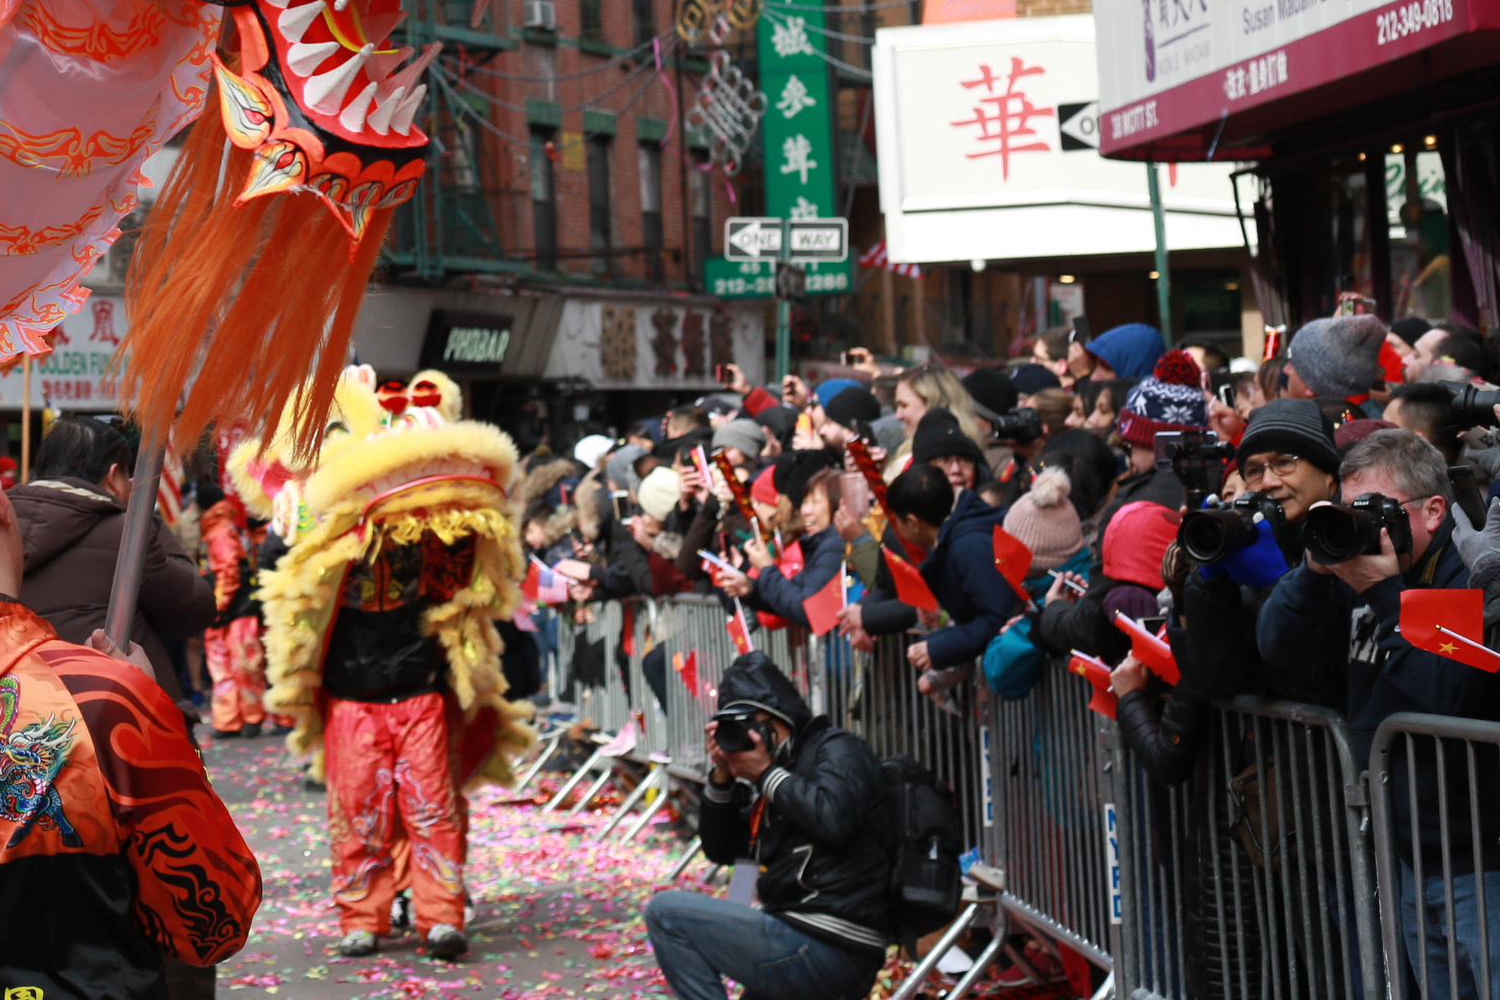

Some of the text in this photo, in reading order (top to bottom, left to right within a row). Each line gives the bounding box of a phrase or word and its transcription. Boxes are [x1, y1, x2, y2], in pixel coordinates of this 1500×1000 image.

[1243, 4, 1276, 35] Susan
[950, 56, 1054, 182] 華
[742, 232, 837, 247] ONE WAY
